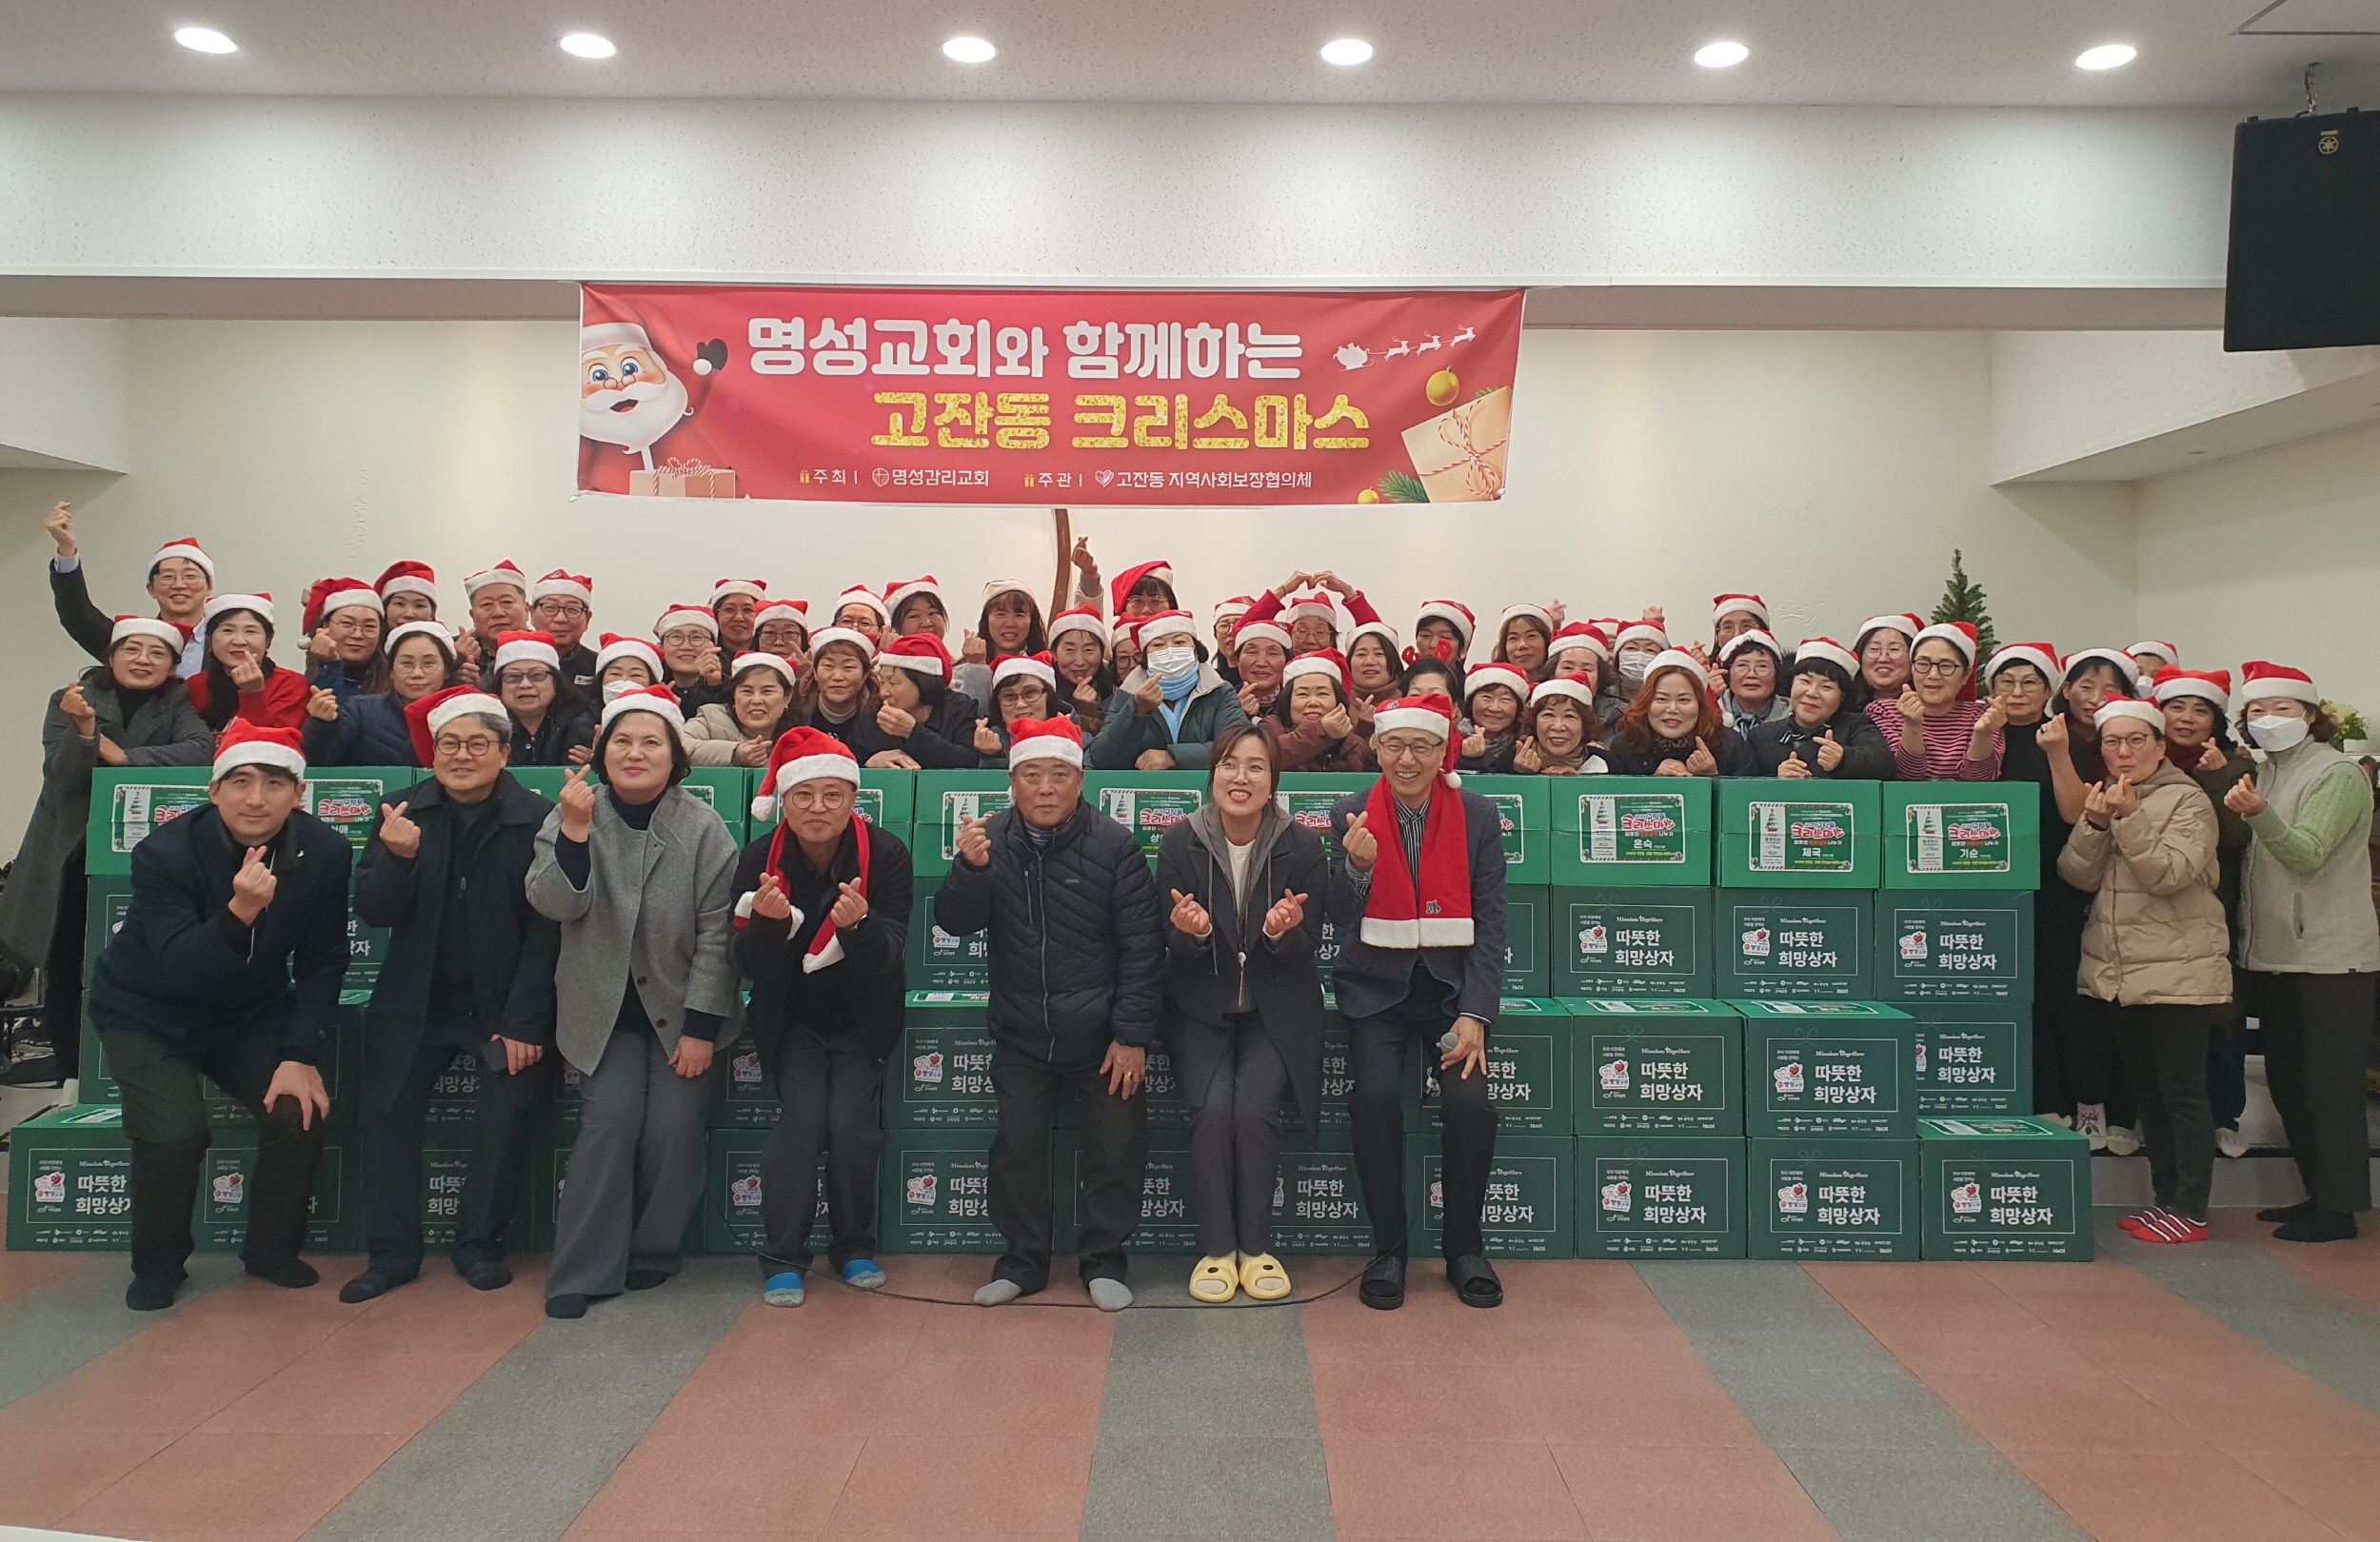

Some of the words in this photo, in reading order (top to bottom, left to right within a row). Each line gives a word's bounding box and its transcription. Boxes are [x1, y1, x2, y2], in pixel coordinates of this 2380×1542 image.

[748, 317, 1049, 378] 명성교회와
[1062, 320, 1303, 380] 함께하는
[871, 391, 1052, 449] 고잔동
[1071, 392, 1370, 450] 크리스마스
[892, 468, 989, 486] 명성감리교회
[1117, 471, 1164, 488] 고잔동
[1168, 471, 1312, 488] 지역사회보장협의체
[1150, 834, 1163, 842] 상
[1616, 930, 1660, 946] 따뜻한
[1780, 931, 1824, 947] 따뜻한
[1940, 934, 1984, 950] 따뜻한
[1615, 950, 1675, 966] 희망상자
[1778, 951, 1837, 967] 희망상자
[1938, 954, 1997, 970] 희망상자
[447, 1055, 477, 1071] 뜻한
[1145, 1054, 1170, 1071] 뜻한
[1939, 1046, 1982, 1063] 따뜻한
[1487, 1061, 1517, 1079] 뜻한
[1641, 1062, 1688, 1079] 따뜻한
[1815, 1065, 1862, 1081] 따뜻한
[1937, 1067, 1996, 1083] 희망상자
[432, 1076, 479, 1093] 망상
[952, 1076, 995, 1093] 희망상
[1487, 1083, 1531, 1100] 망상자
[1640, 1083, 1703, 1100] 희망상자
[1815, 1086, 1876, 1103] 희망상자
[78, 1176, 127, 1193] 따뜻한
[430, 1176, 466, 1194] 따뜻
[1143, 1177, 1170, 1195] 뜻한
[1298, 1179, 1344, 1196] 따뜻한
[1484, 1184, 1519, 1200] 뜻한
[1645, 1185, 1692, 1202] 따뜻한
[1819, 1186, 1866, 1203] 따뜻한
[1991, 1186, 2038, 1203] 따뜻한
[427, 1197, 461, 1215] 희망
[1141, 1199, 1185, 1217] 망상자
[1296, 1201, 1359, 1218] 희망상자
[1644, 1206, 1706, 1223] 희망상자
[1817, 1208, 1880, 1225] 희망상자
[1990, 1208, 2053, 1225] 희망상자
